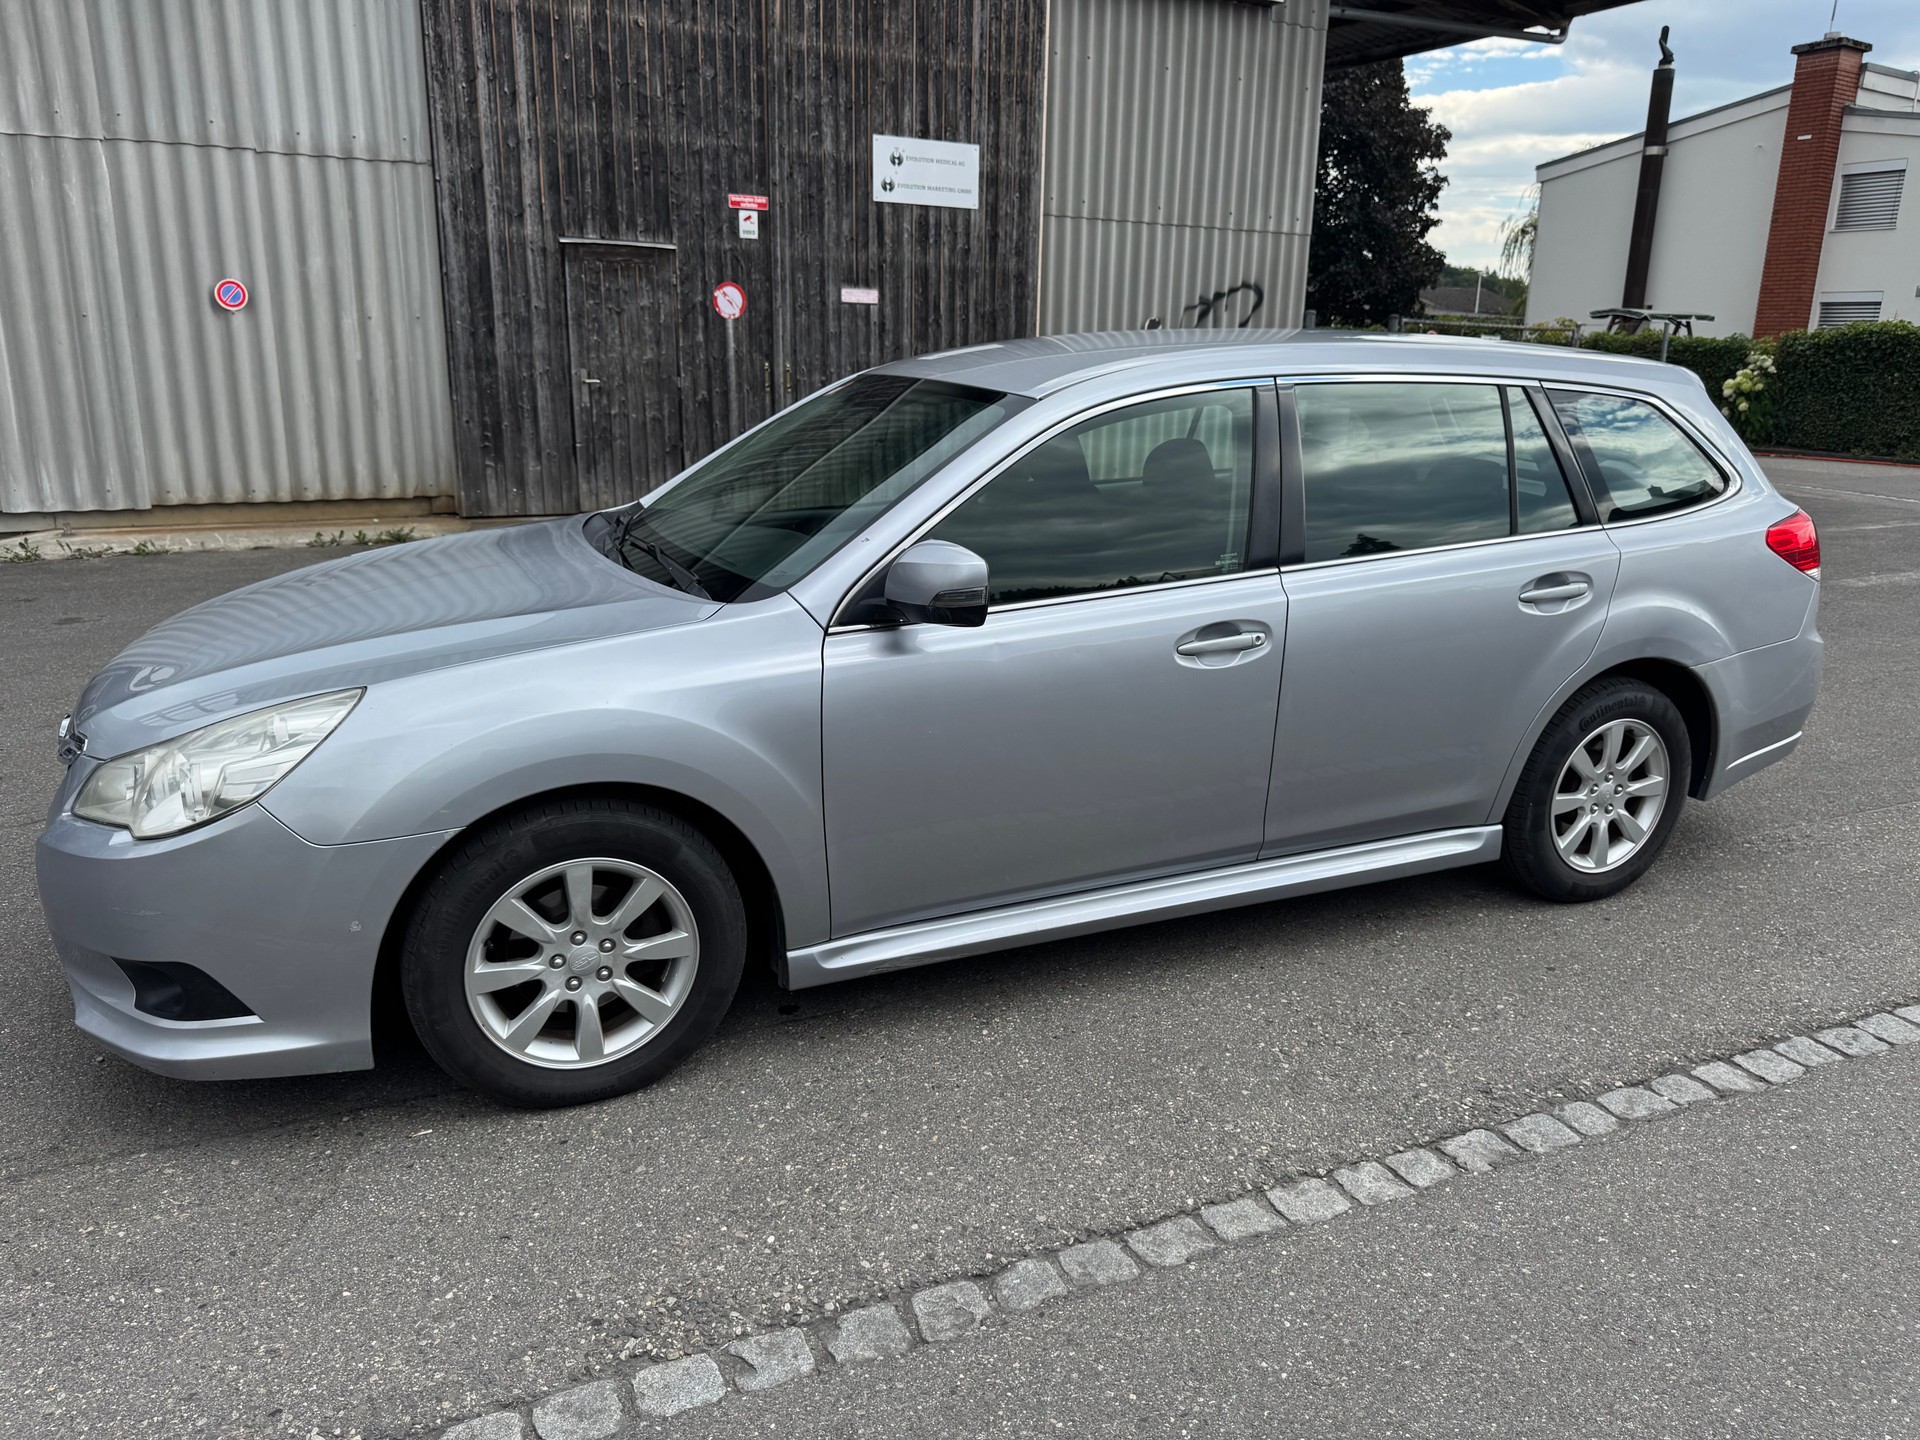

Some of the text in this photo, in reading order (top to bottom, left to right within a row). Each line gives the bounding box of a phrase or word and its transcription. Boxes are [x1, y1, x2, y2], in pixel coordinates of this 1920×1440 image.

[906, 155, 935, 164] EVOLUTION
[935, 158, 957, 166] MEDICAL
[927, 185, 957, 193] MARKETING
